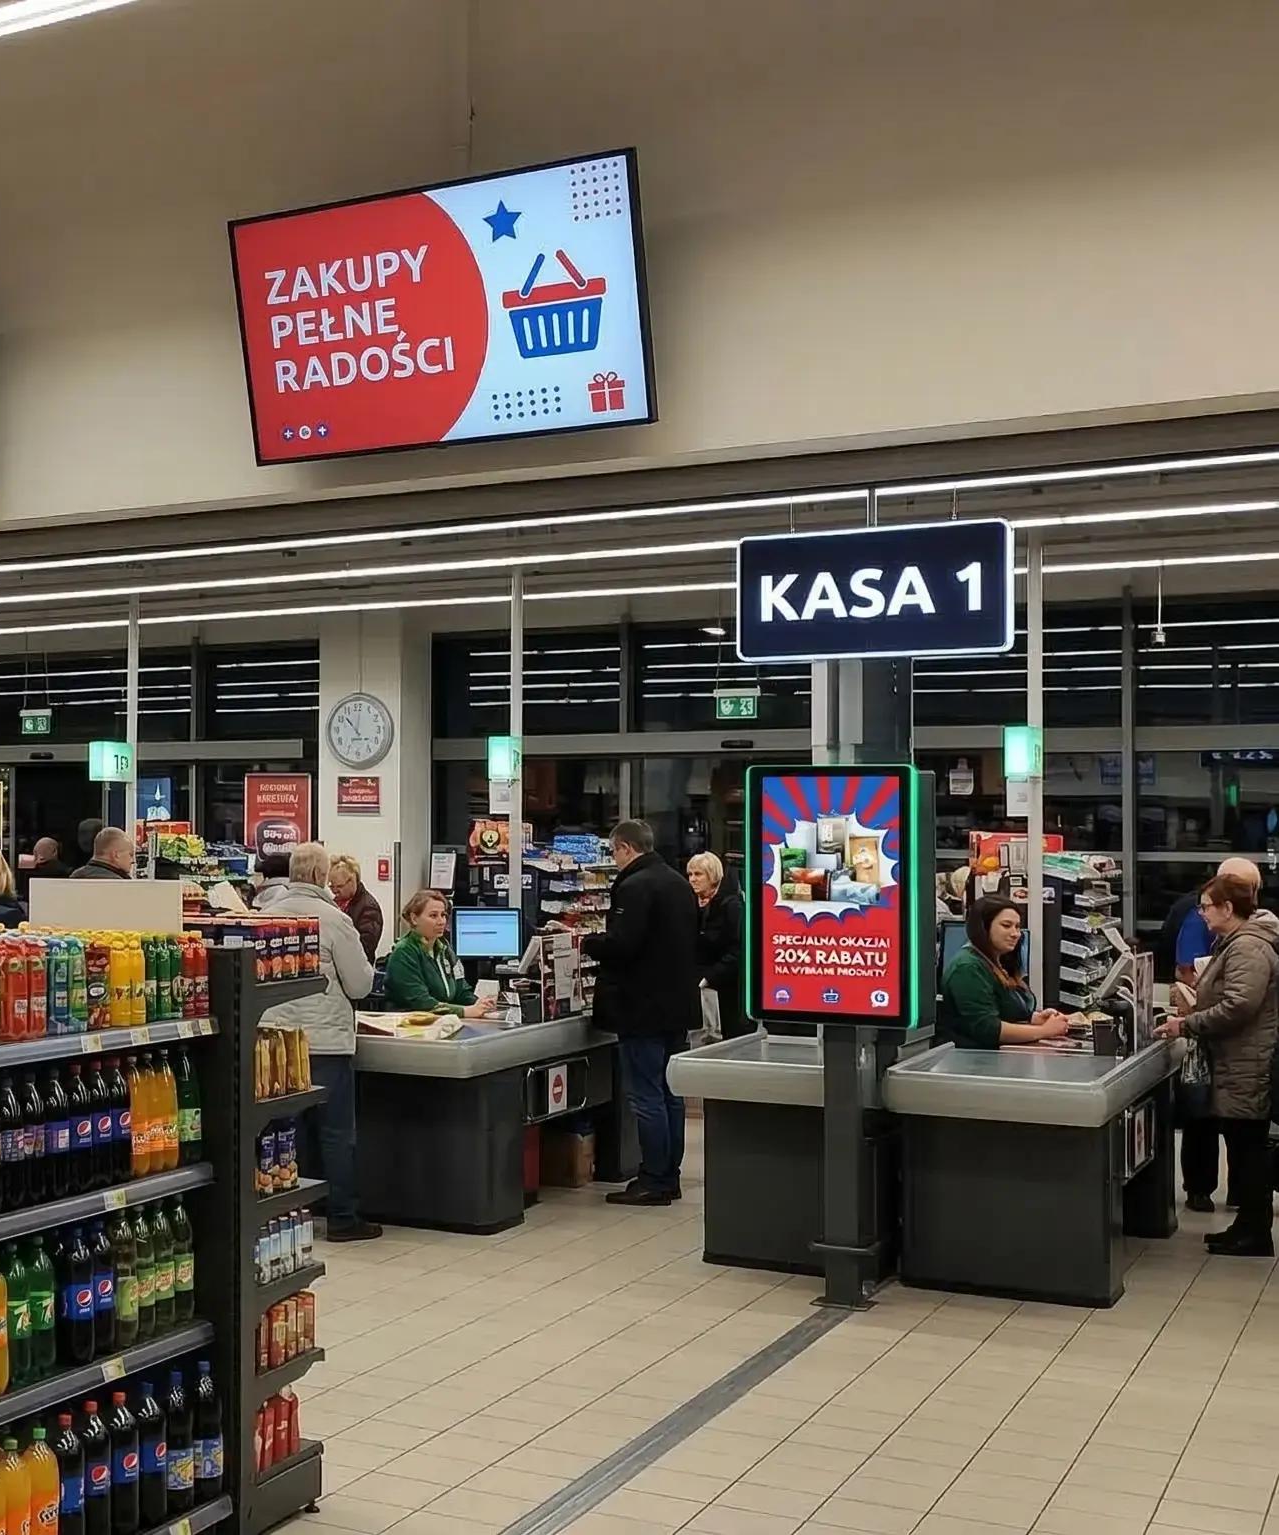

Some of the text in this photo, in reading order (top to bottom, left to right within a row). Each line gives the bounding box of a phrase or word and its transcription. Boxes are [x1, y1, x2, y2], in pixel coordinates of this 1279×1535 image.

[263, 244, 430, 306] ZAKUPY
[270, 297, 400, 350] PEŁNE
[274, 330, 456, 394] RADOŚCI
[760, 561, 983, 623] KASA 1
[772, 934, 838, 947] SPECJALNA
[773, 948, 888, 967] 20% RABATU
[774, 965, 790, 975] NA
